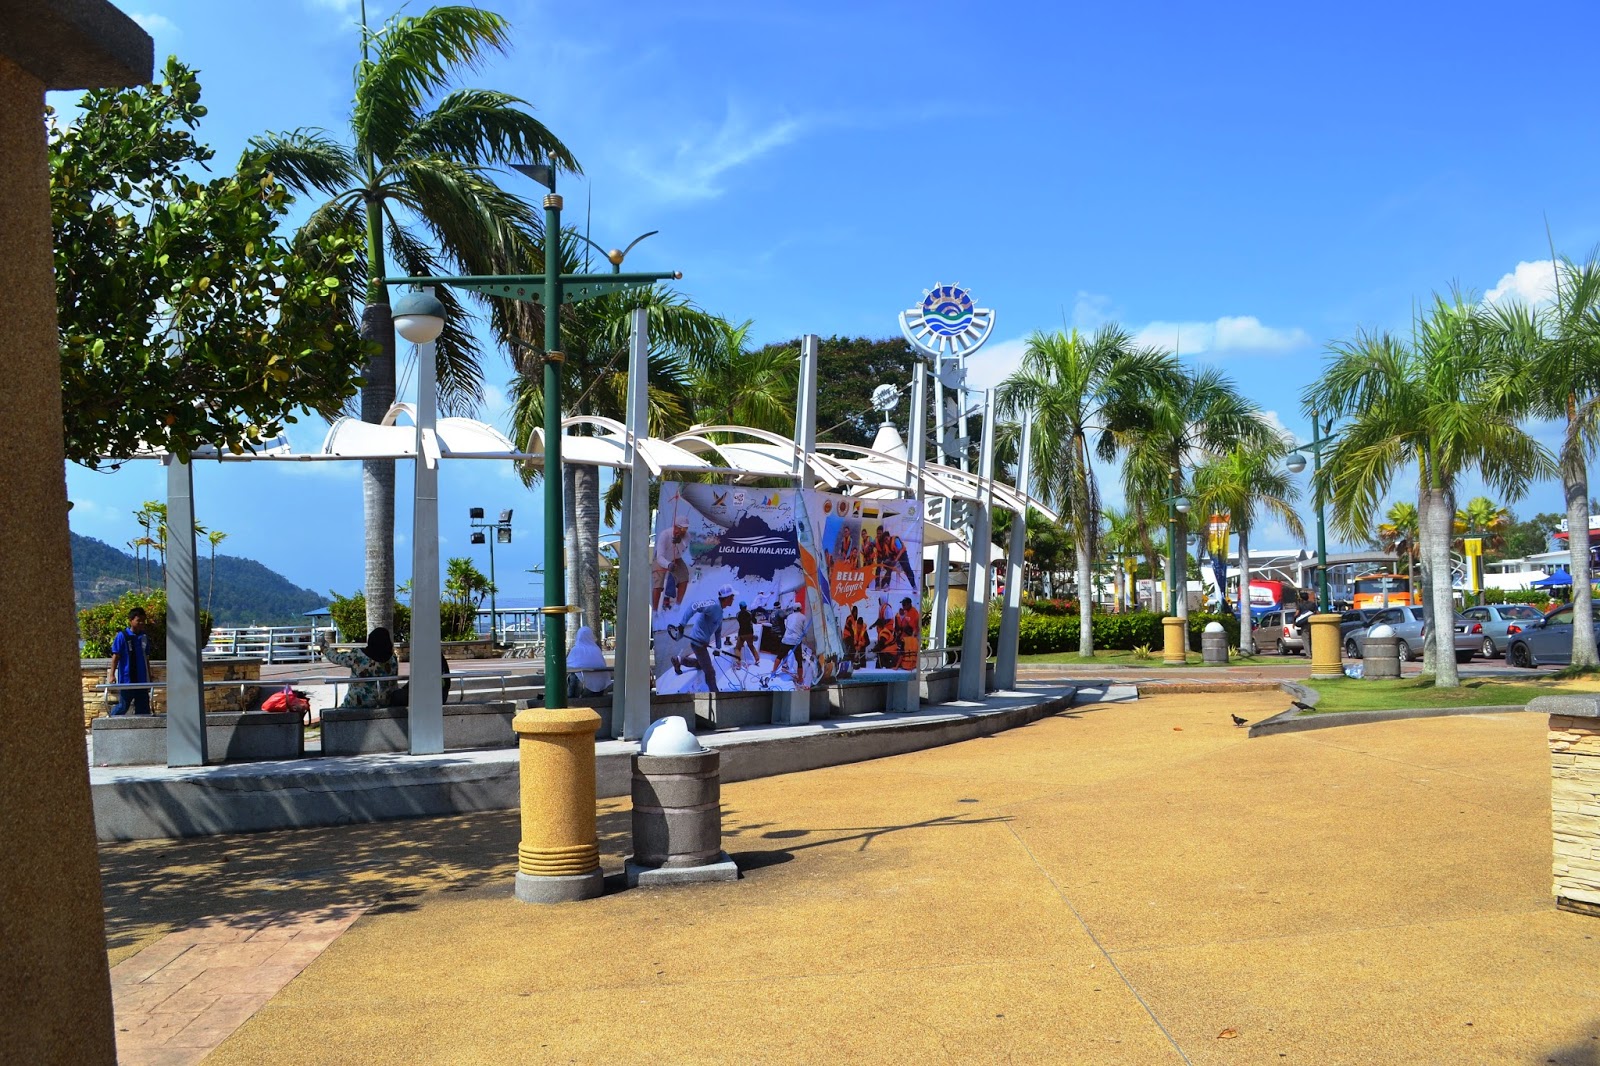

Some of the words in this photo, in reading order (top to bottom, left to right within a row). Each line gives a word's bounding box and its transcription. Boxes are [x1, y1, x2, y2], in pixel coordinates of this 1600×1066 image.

[718, 546, 735, 554] LIGA
[759, 547, 796, 556] MALAYSIA
[836, 571, 865, 582] BELIA
